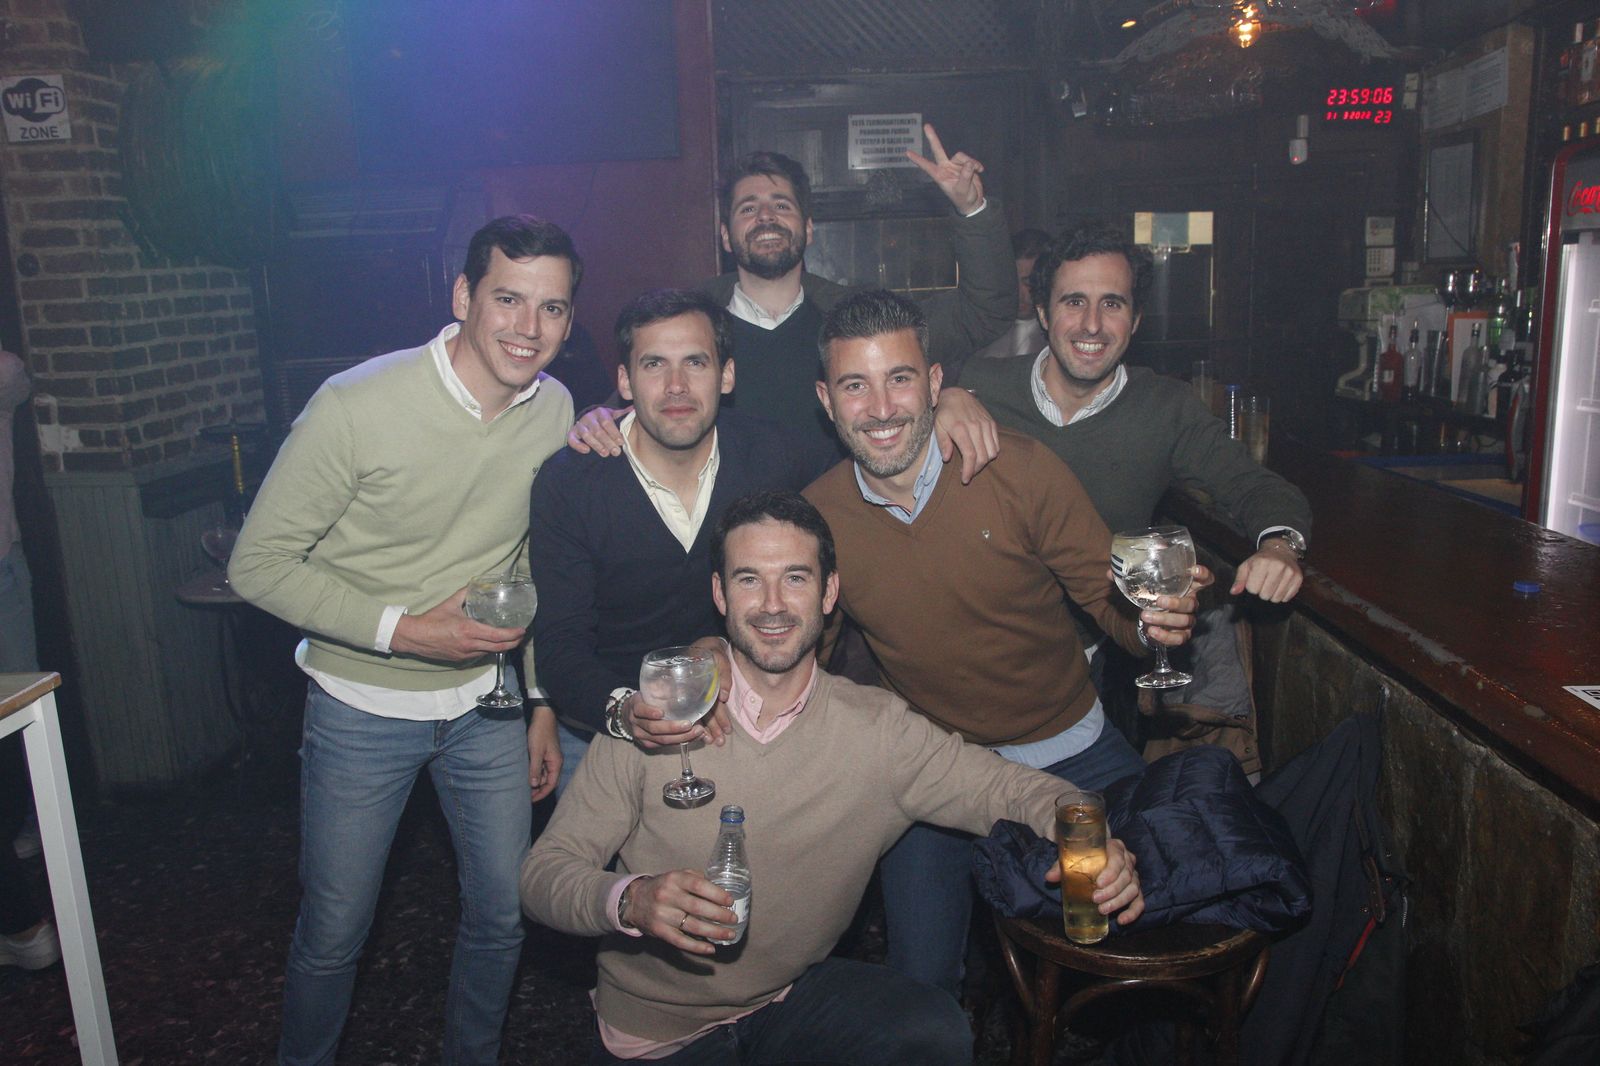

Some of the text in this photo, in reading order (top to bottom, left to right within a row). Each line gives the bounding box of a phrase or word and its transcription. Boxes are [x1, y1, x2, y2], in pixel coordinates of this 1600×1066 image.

[1327, 87, 1393, 105] 23:59:06
[1374, 110, 1392, 124] 23
[20, 126, 59, 139] ZONE
